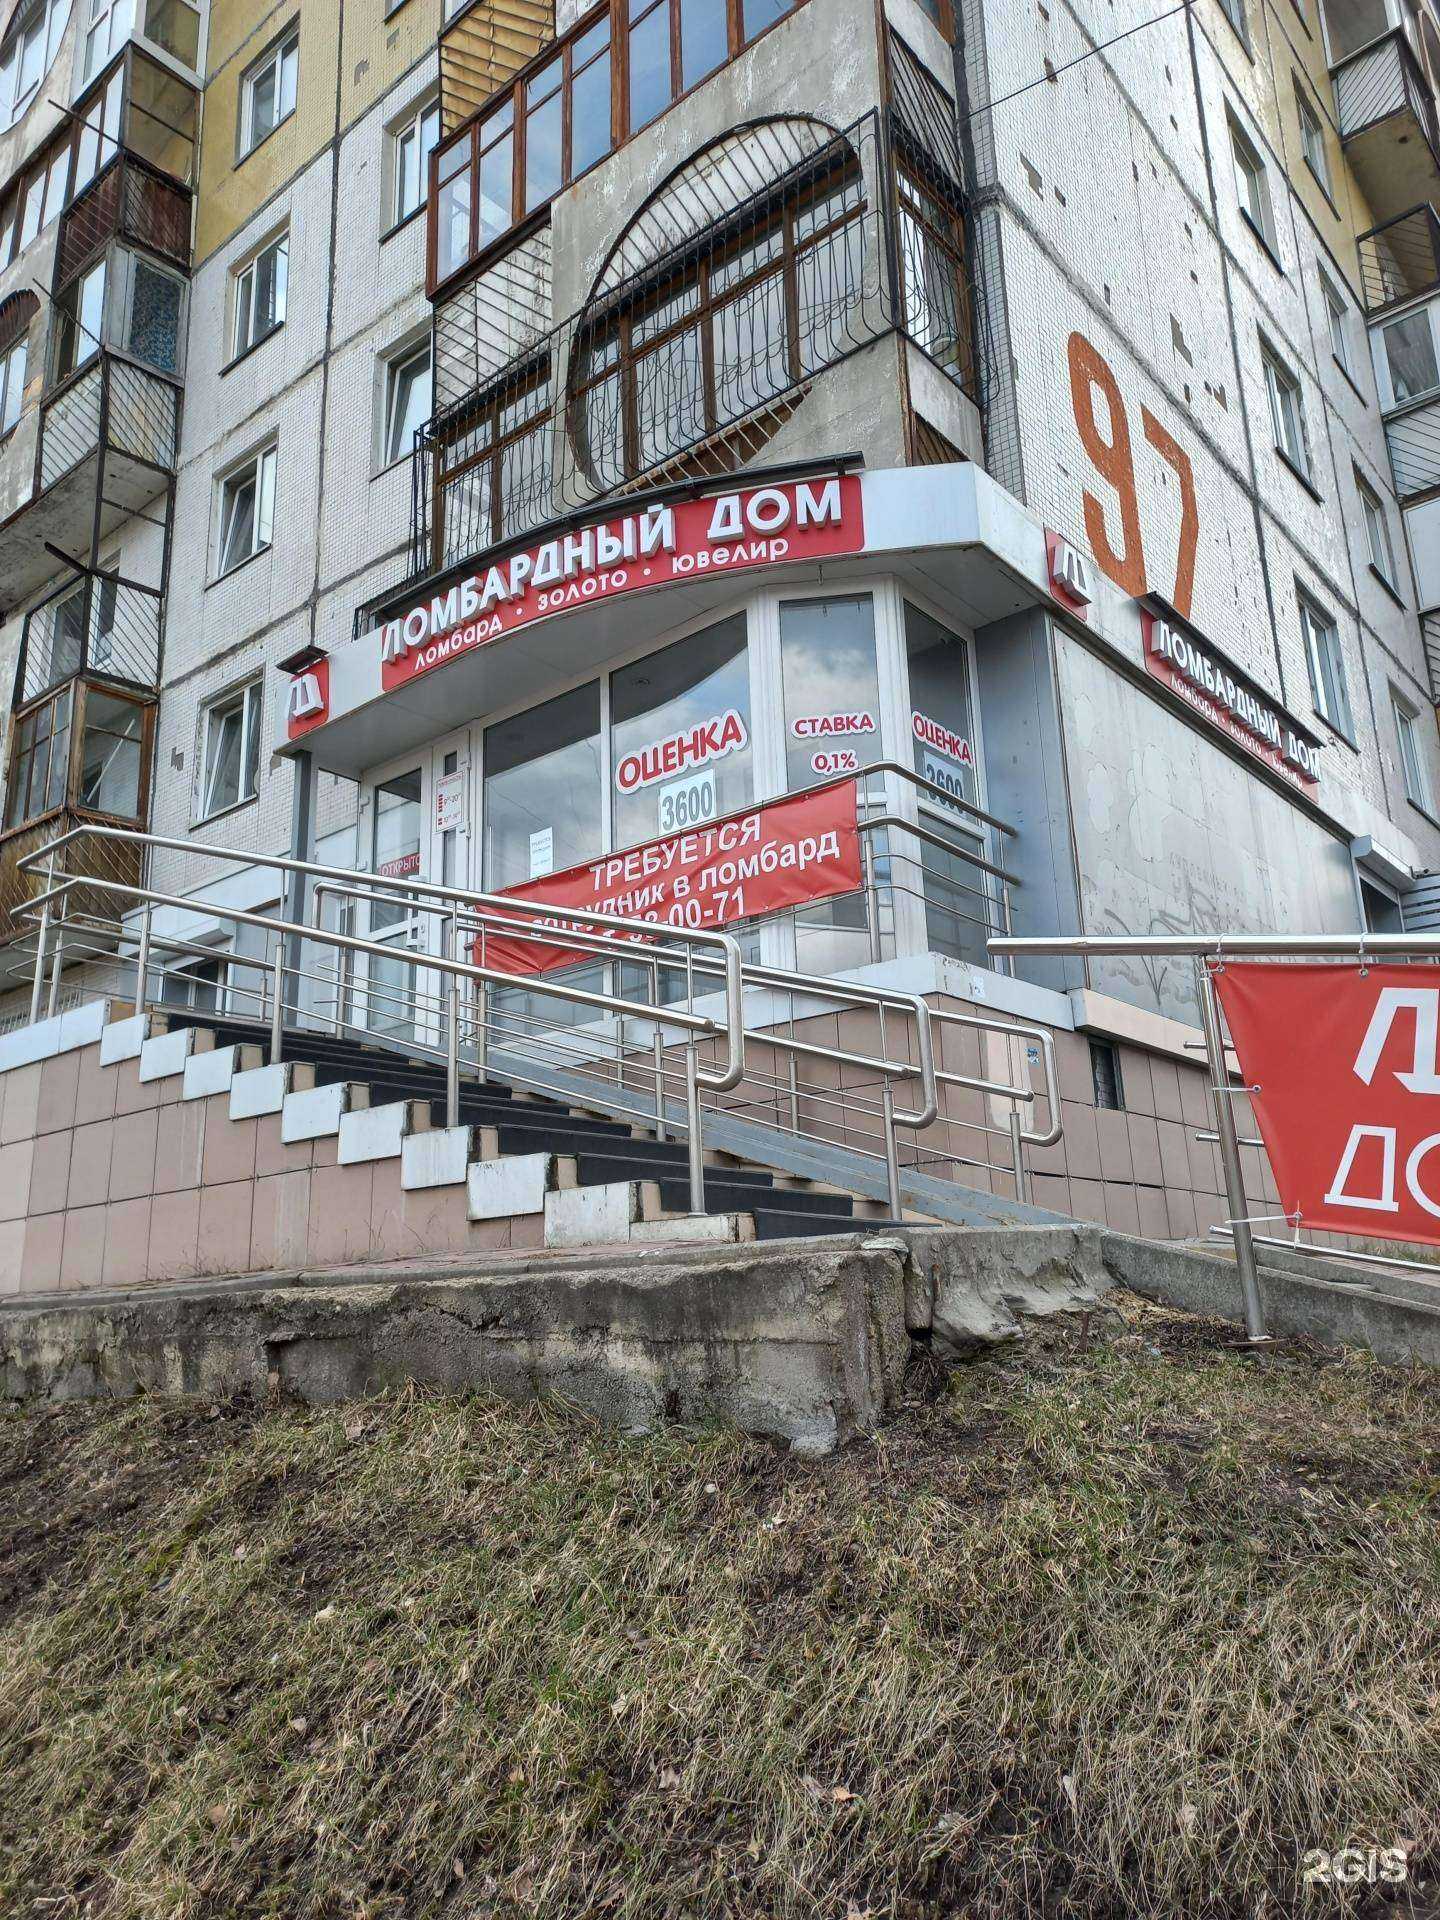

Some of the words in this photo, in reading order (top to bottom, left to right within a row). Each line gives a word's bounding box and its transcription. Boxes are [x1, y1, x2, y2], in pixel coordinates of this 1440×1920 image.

[1067, 331, 1199, 620] 97
[382, 503, 676, 665] ЛОМБАРДНЫЙ
[707, 480, 842, 543] ДОМ
[415, 613, 503, 671] ломбард
[537, 569, 628, 612] золото
[672, 538, 789, 574] ювелир
[794, 713, 874, 735] СТАВКА
[1155, 619, 1283, 750] ЛОМБАРДНЫЙ
[1285, 730, 1322, 783] ДОМ
[618, 714, 743, 788] ОЦЕНКА
[814, 752, 857, 773] 0,1%
[913, 714, 972, 764] ОЦЕНКА
[661, 781, 713, 831] 3600
[590, 813, 762, 891] ТРЕБУЕТСЯ
[698, 830, 841, 892] ломбард
